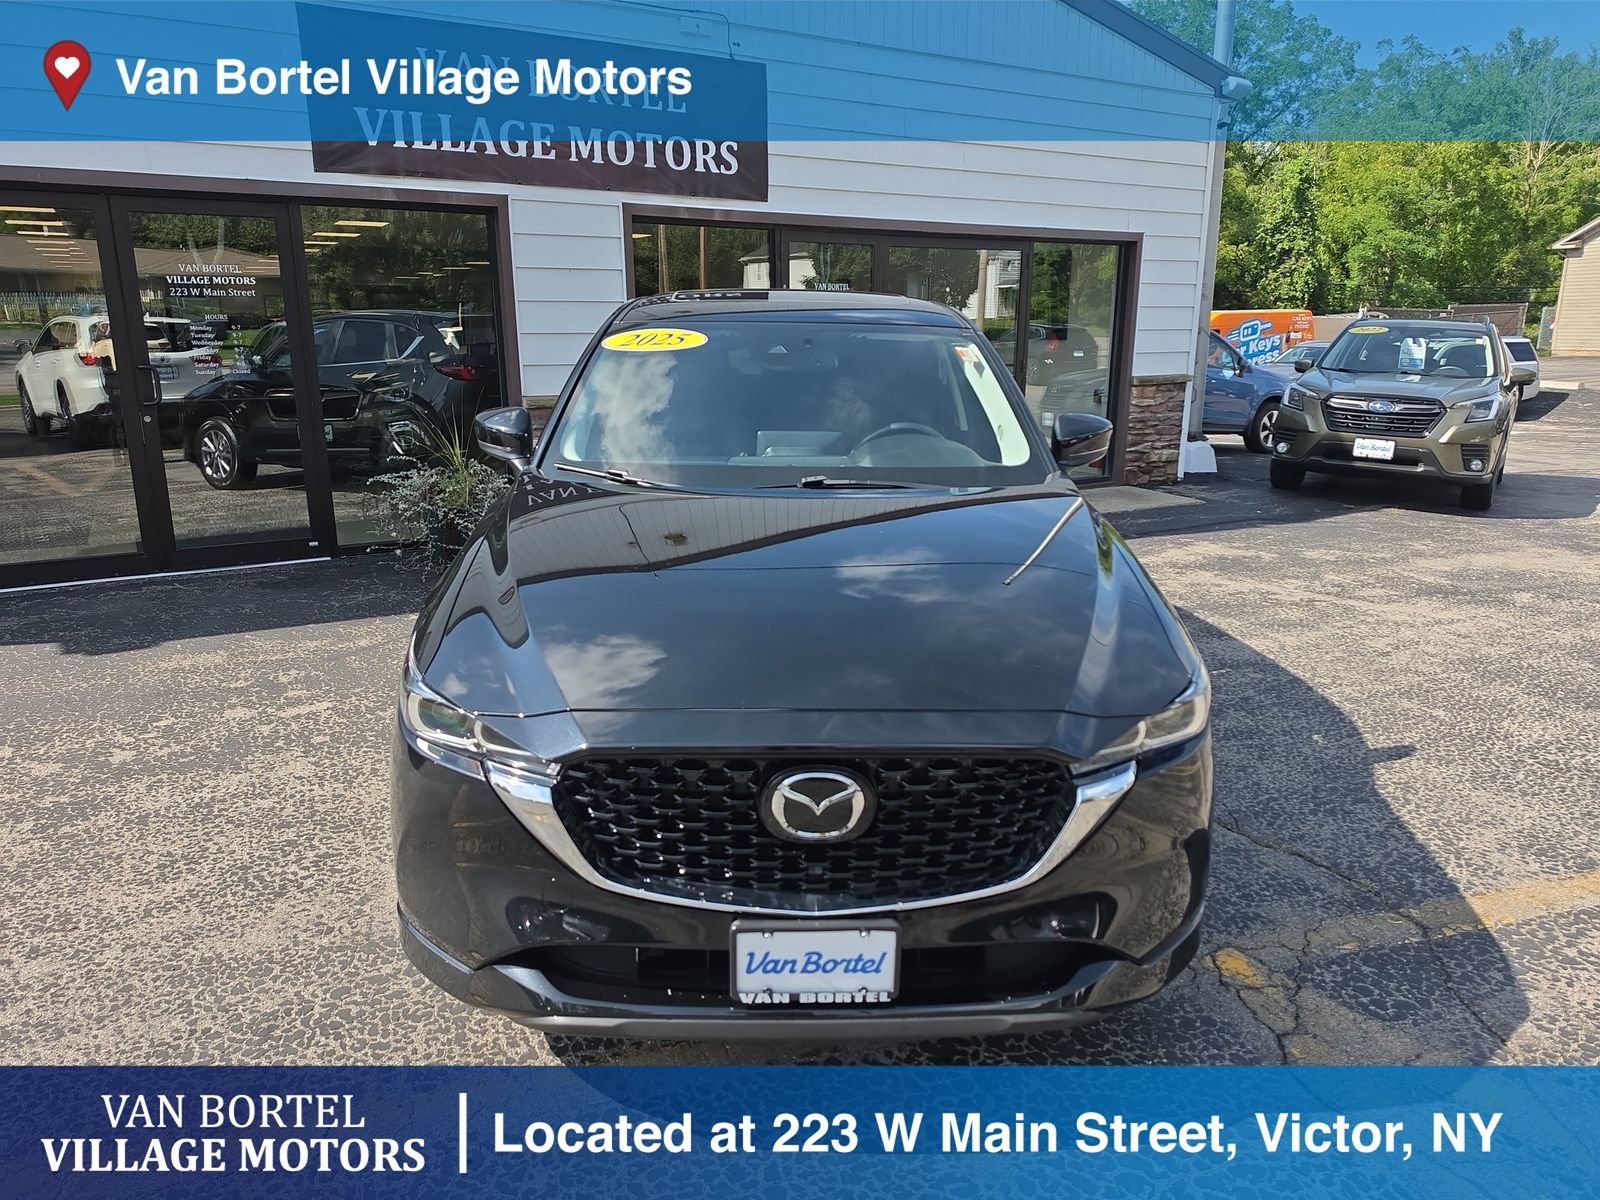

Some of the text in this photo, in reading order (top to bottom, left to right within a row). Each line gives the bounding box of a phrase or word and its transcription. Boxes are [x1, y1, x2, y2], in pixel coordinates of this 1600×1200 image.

[353, 106, 740, 175] VILLAGE MOTORS
[178, 263, 242, 273] VAN BORTEL
[166, 275, 257, 285] VILLAGE MOTORS
[814, 282, 850, 291] VAN BORTEL
[169, 287, 256, 297] 223 W Main Street
[618, 332, 692, 347] 2025
[1248, 335, 1281, 354] Keys
[195, 368, 217, 376] Sunday
[1356, 442, 1370, 450] Van
[745, 951, 888, 974] Van Bortel
[738, 991, 892, 1004] VAN BORTEL
